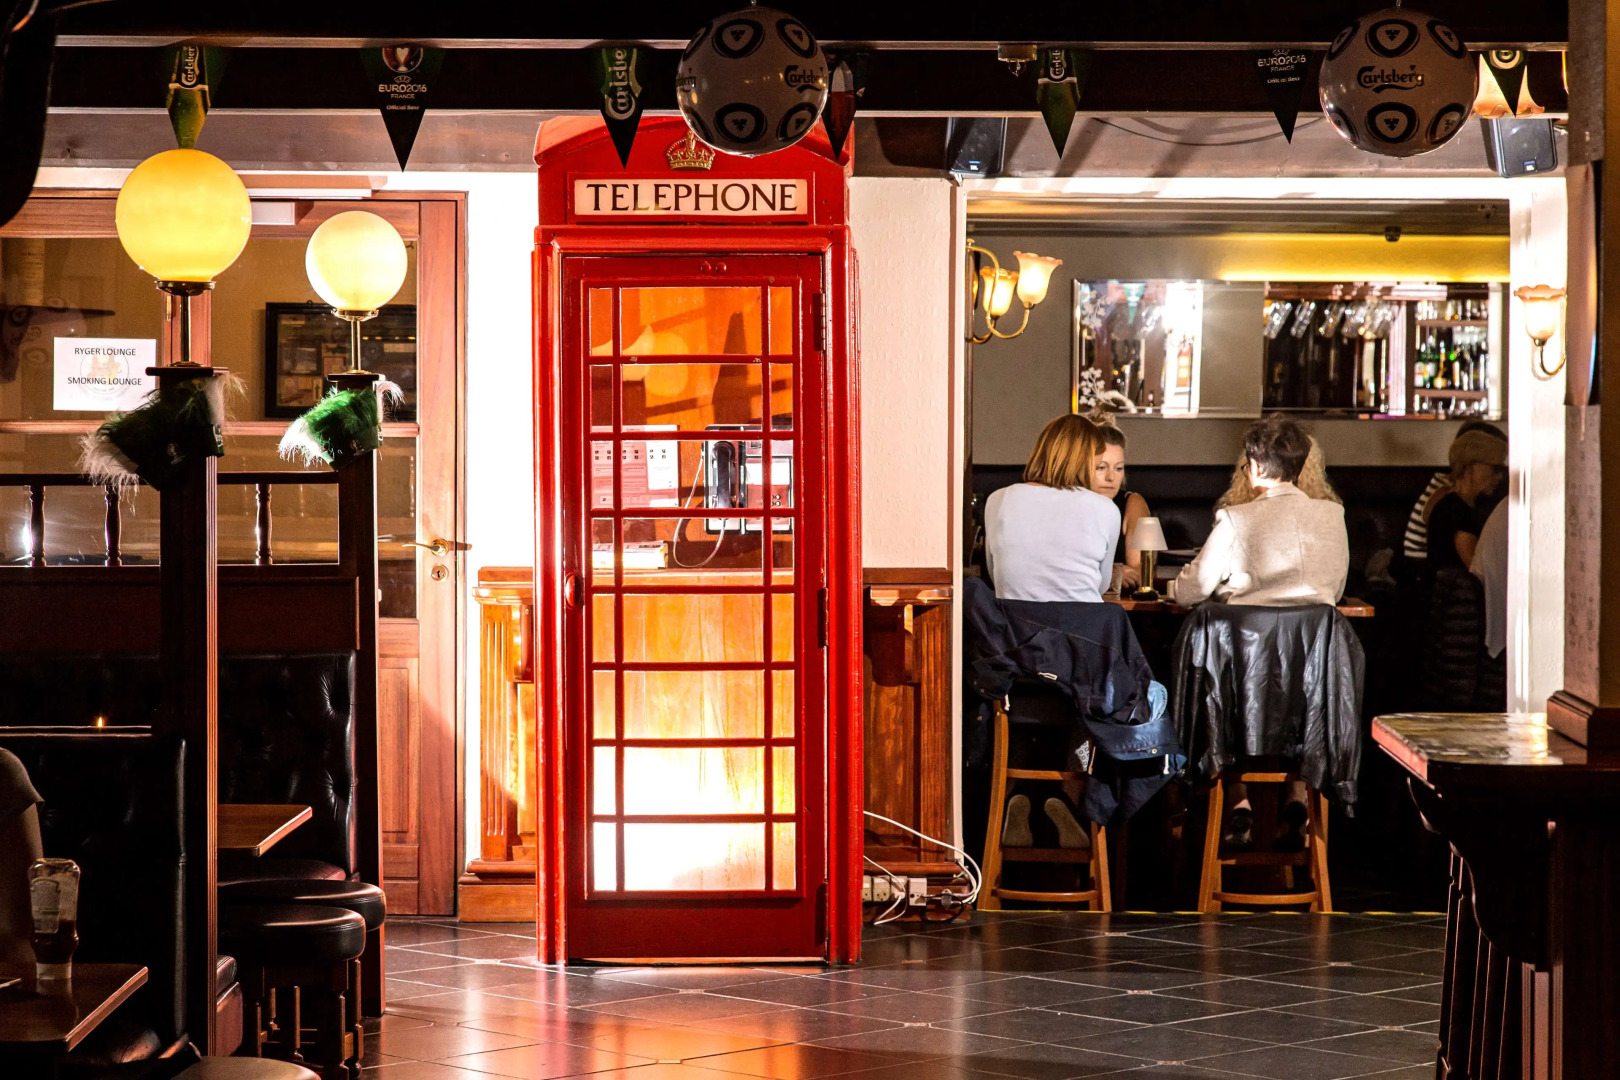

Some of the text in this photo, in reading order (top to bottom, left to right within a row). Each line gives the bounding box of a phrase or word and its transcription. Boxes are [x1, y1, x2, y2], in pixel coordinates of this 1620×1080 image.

[1357, 65, 1425, 92] Carlsberg
[378, 84, 428, 93] EURO2016
[586, 182, 798, 212] TELEPHONE
[74, 347, 136, 356] RYGER LOUNGE
[67, 377, 142, 386] SMOKING LOUNGE
